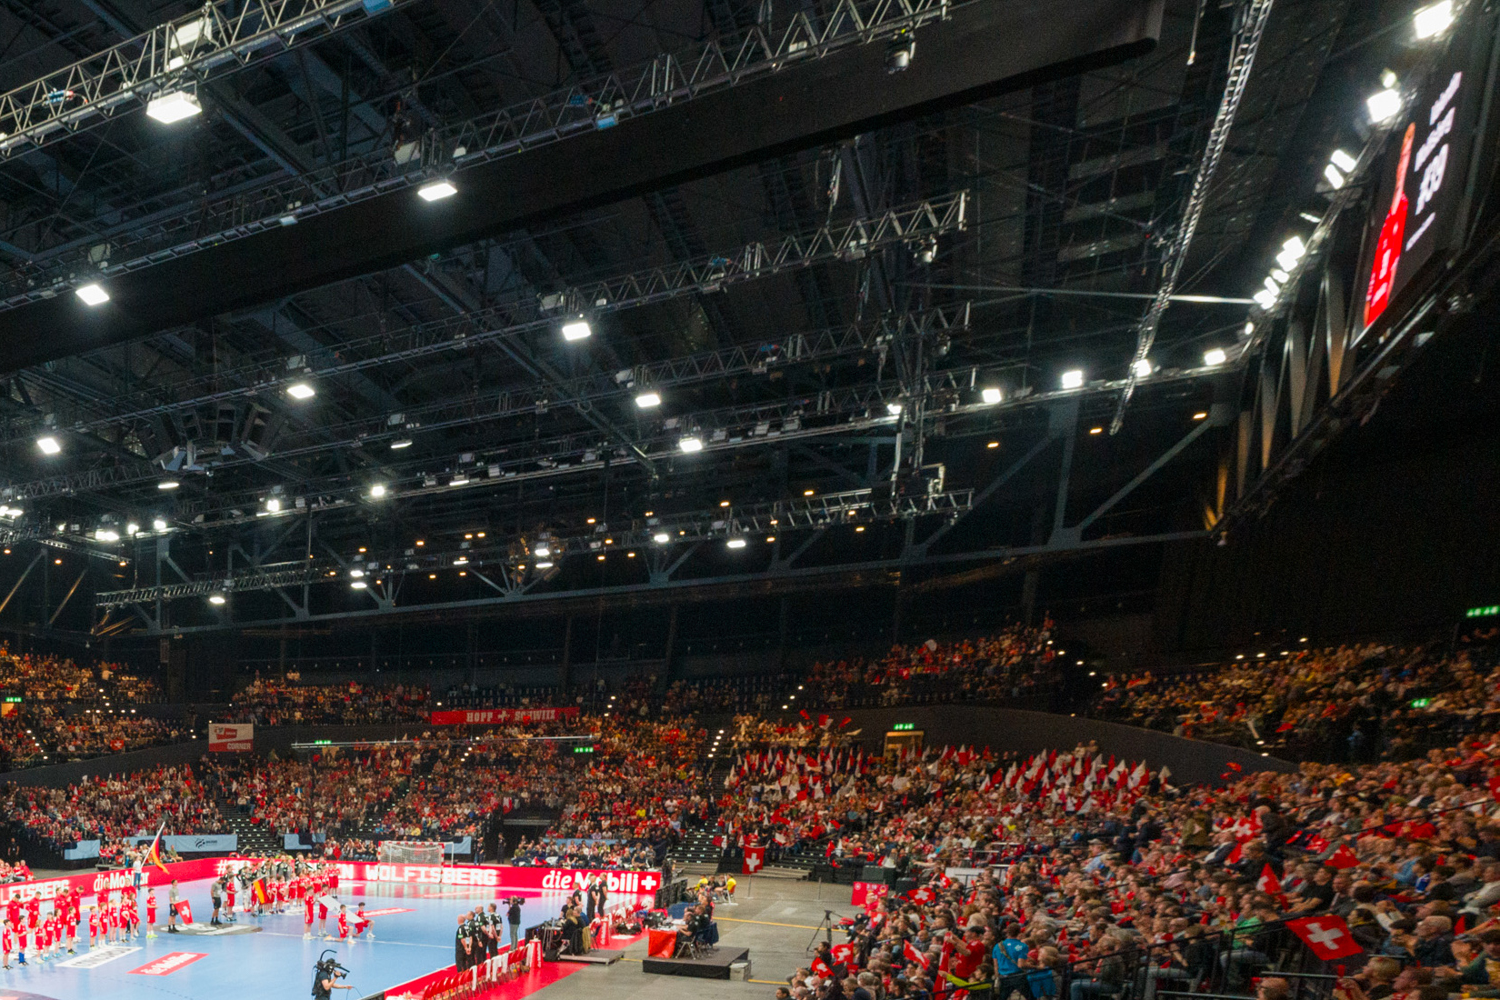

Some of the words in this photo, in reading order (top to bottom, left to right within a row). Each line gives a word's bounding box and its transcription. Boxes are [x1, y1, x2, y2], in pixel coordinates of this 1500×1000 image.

[466, 711, 494, 723] HOPP
[366, 864, 498, 886] WOLFISBERG
[542, 869, 573, 889] die
